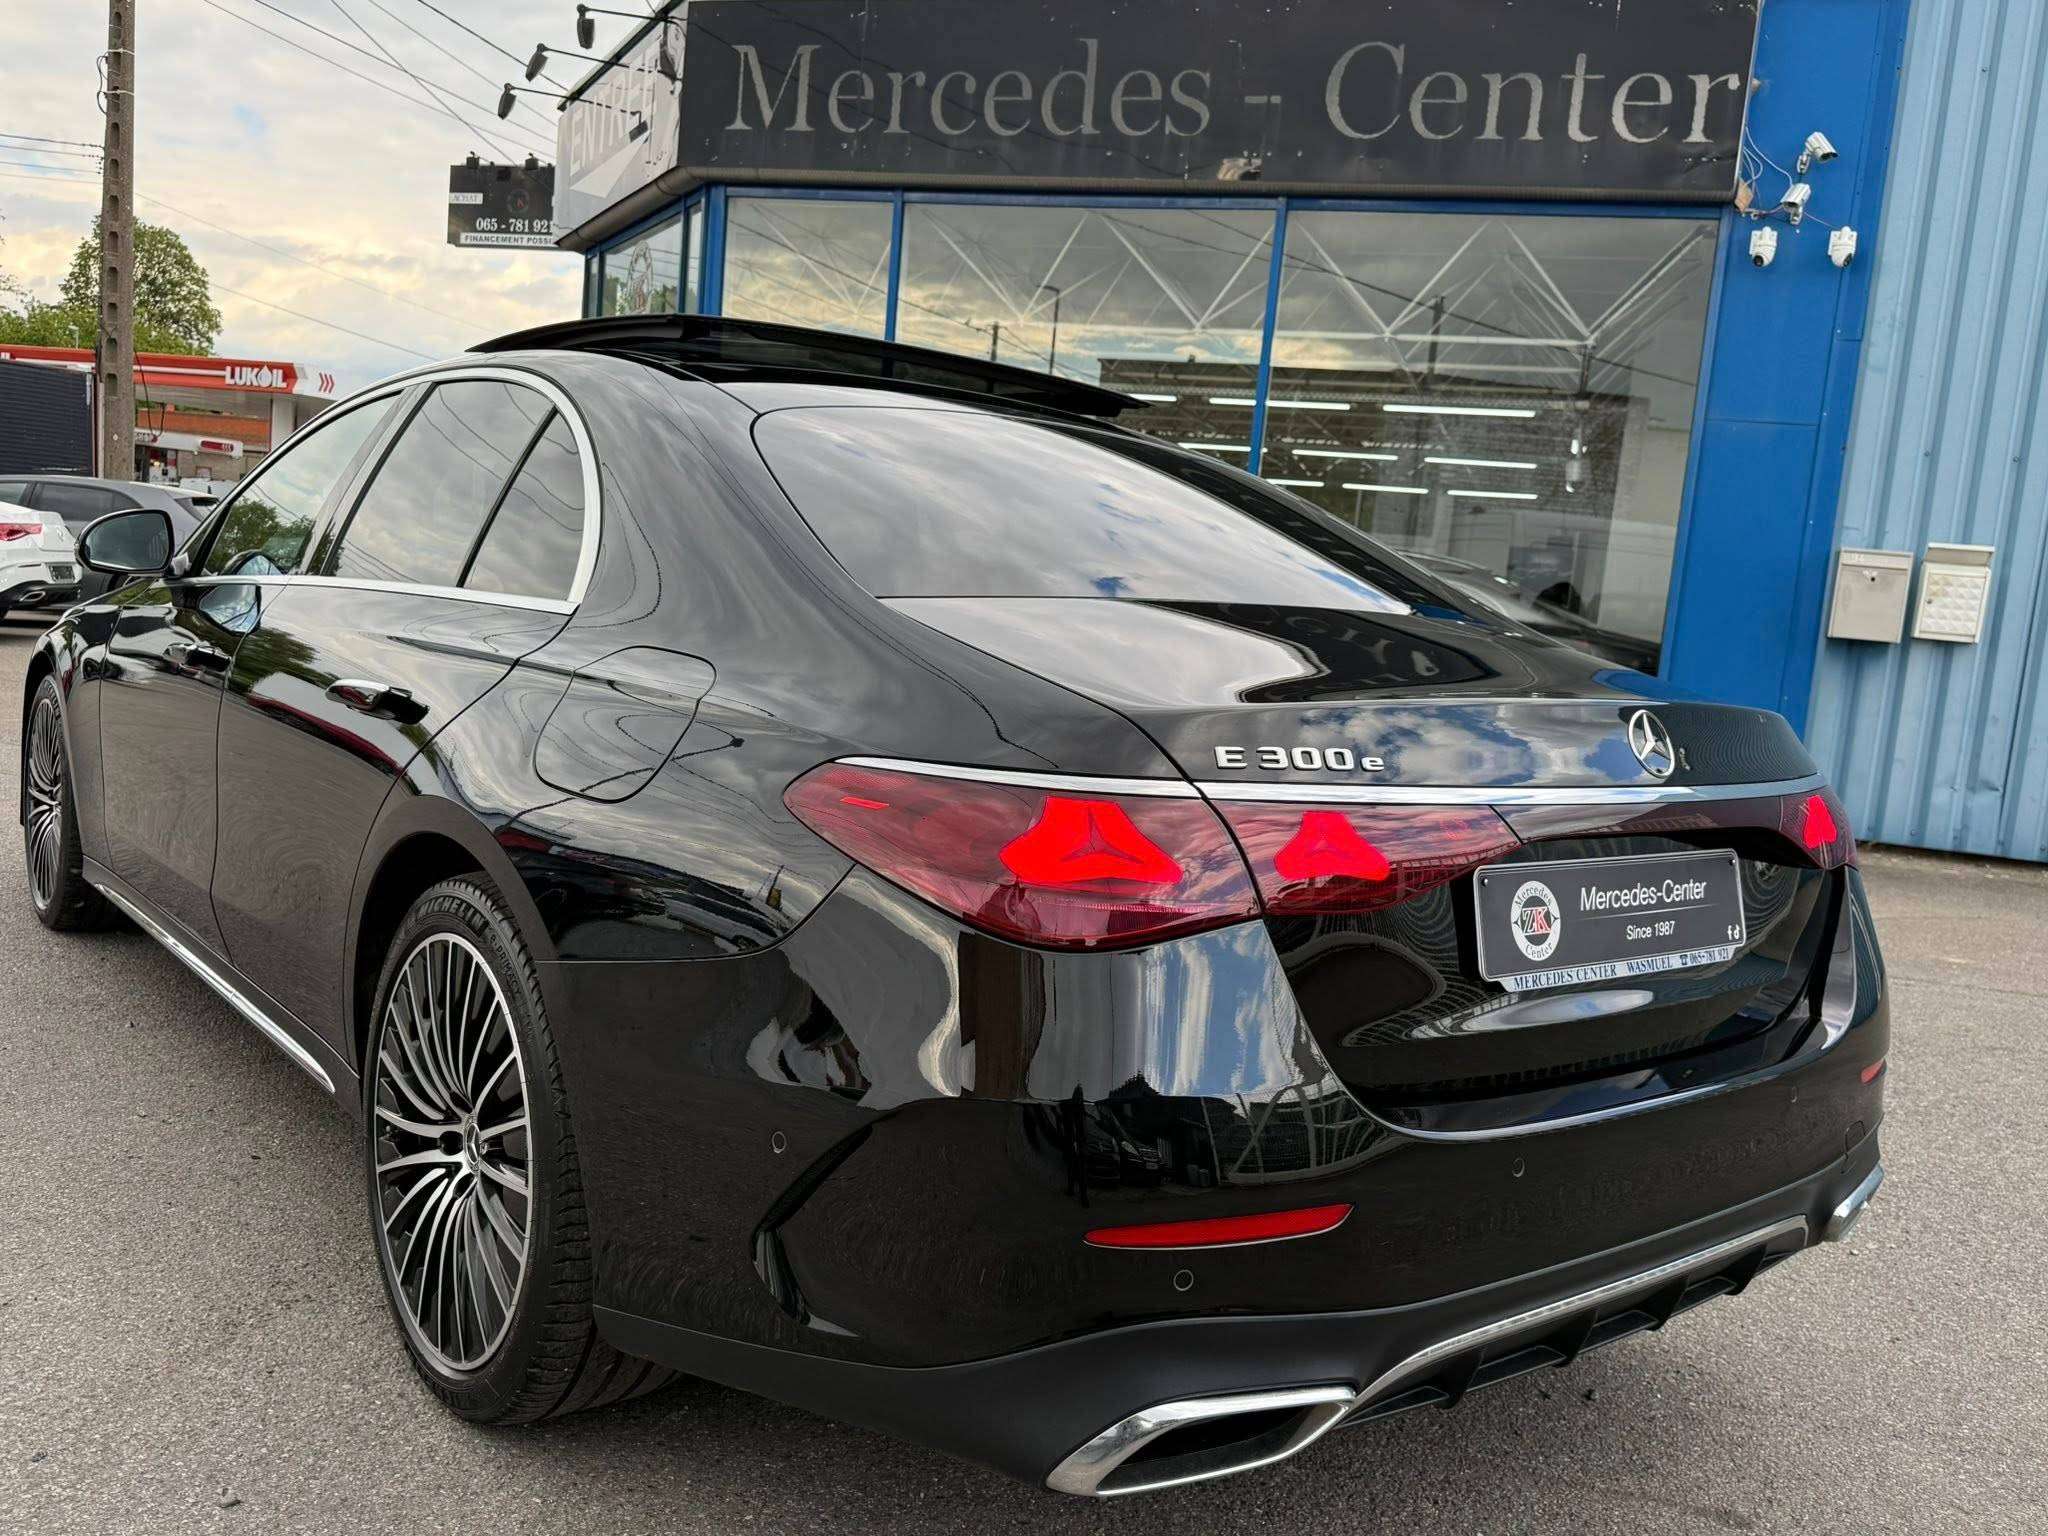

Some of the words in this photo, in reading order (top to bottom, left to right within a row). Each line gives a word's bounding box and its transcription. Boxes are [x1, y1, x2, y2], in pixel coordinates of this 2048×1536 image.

[725, 38, 1211, 136] Mercedes
[1324, 41, 1740, 143] Center
[476, 218, 498, 231] 065
[509, 219, 529, 232] 781
[465, 235, 524, 244] FINANCEMENT
[225, 365, 287, 388] LUKOIL
[1214, 746, 1248, 769] E
[1580, 879, 1707, 911] Mercedes-Center
[418, 896, 489, 937] MICHELIN
[1626, 925, 1652, 940] Since
[1654, 921, 1675, 937] 1987
[1525, 942, 1553, 958] Center
[1514, 970, 1573, 991] MERCEDES
[1576, 964, 1617, 981] CENTER
[1626, 956, 1673, 972] WASMUEL
